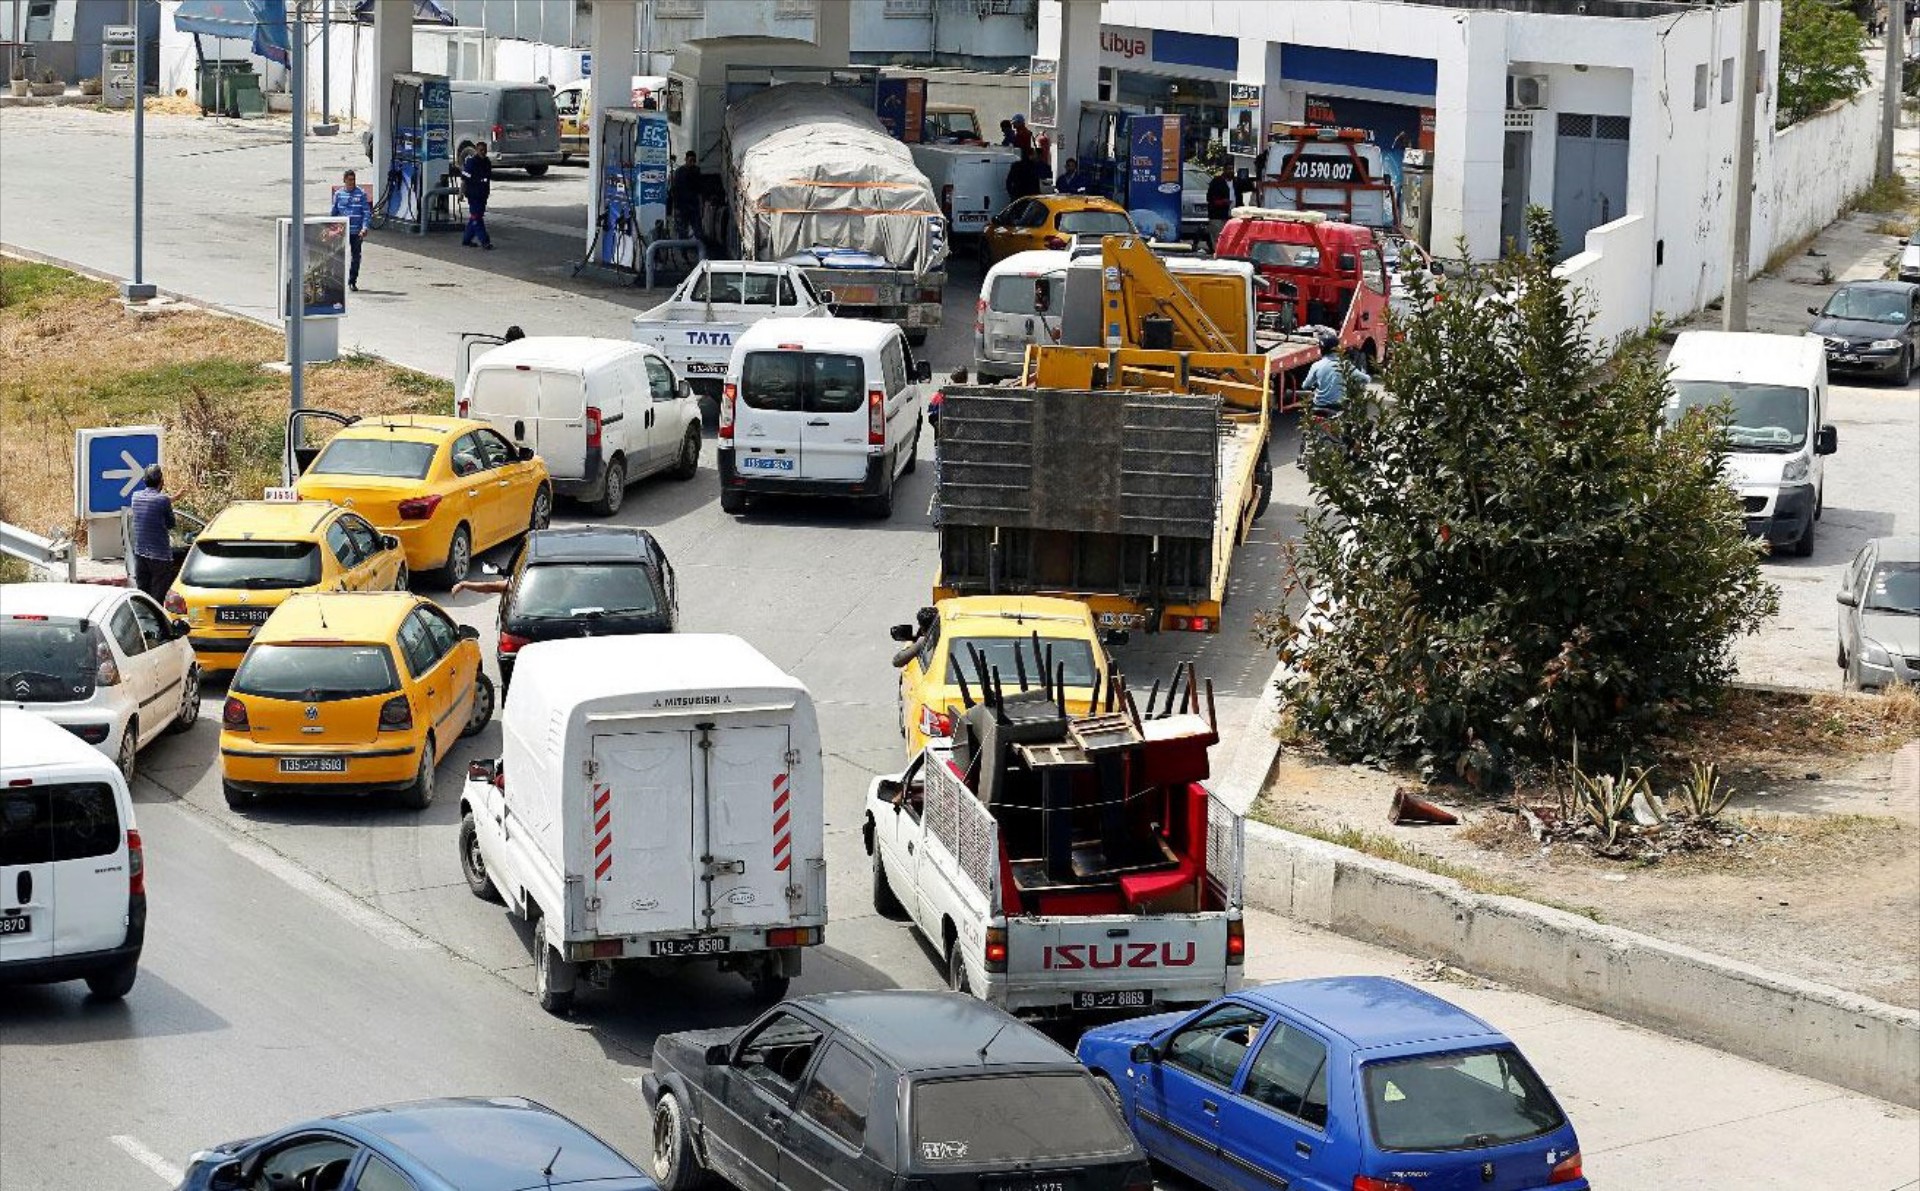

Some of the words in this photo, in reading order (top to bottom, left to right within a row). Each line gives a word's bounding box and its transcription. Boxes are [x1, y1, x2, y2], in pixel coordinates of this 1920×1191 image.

[1101, 32, 1145, 58] Libya
[1294, 161, 1308, 178] 20
[1310, 161, 1330, 179] 590
[1332, 163, 1353, 180] 007
[686, 331, 731, 346] TATA
[664, 696, 720, 706] MITSUBISHI
[284, 760, 300, 771] 135
[655, 941, 674, 955] 149
[698, 938, 725, 951] 8580
[1043, 941, 1196, 970] ISUZU
[1081, 993, 1095, 1008] 59
